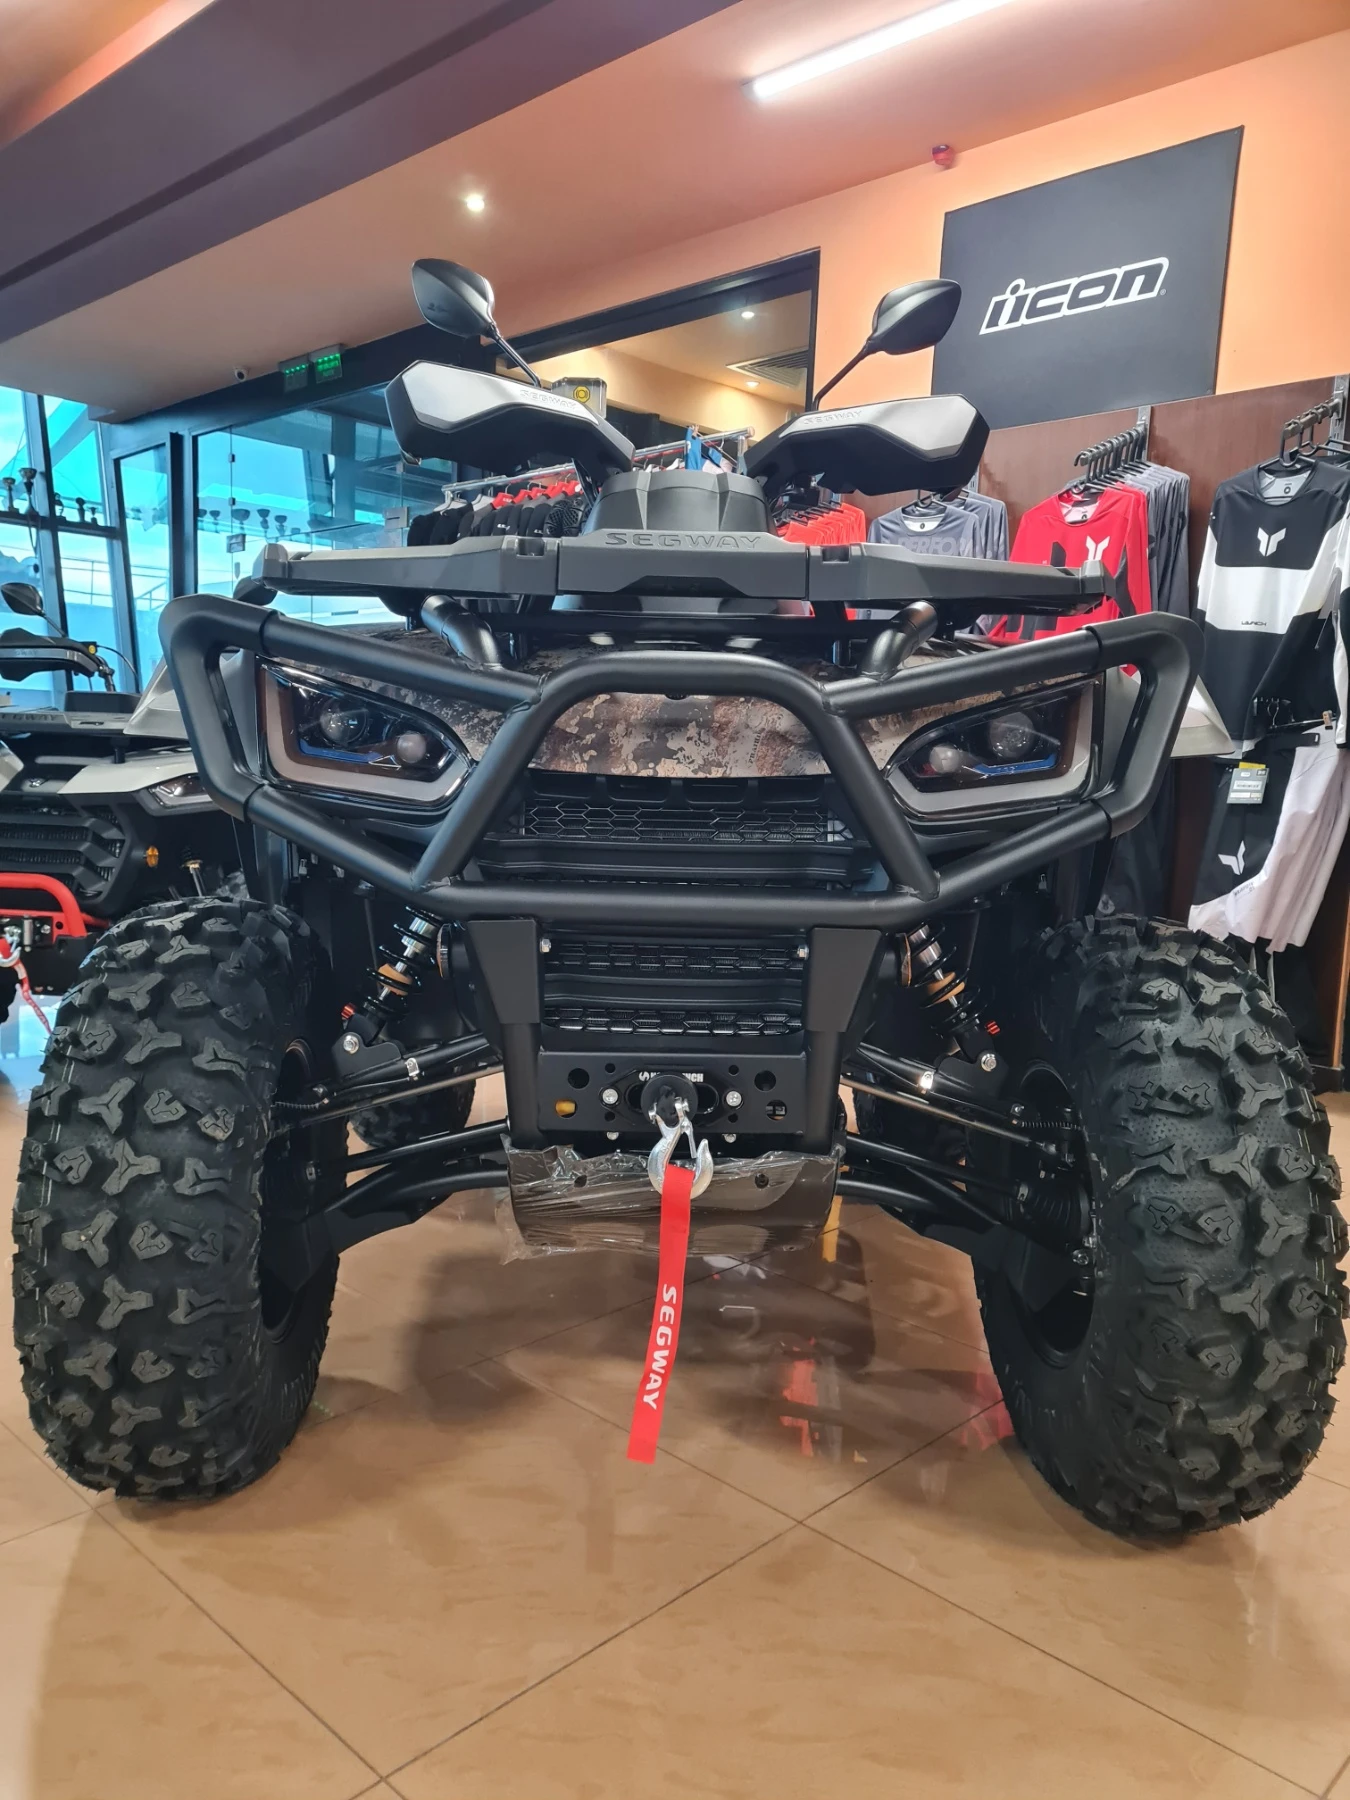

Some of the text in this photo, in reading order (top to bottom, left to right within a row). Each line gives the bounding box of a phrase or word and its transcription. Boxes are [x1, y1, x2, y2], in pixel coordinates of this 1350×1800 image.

[519, 389, 577, 409] SEGWAY
[803, 410, 862, 425] SEGWAY
[605, 532, 761, 549] SEGWAY
[643, 1283, 677, 1410] SEGWAY
